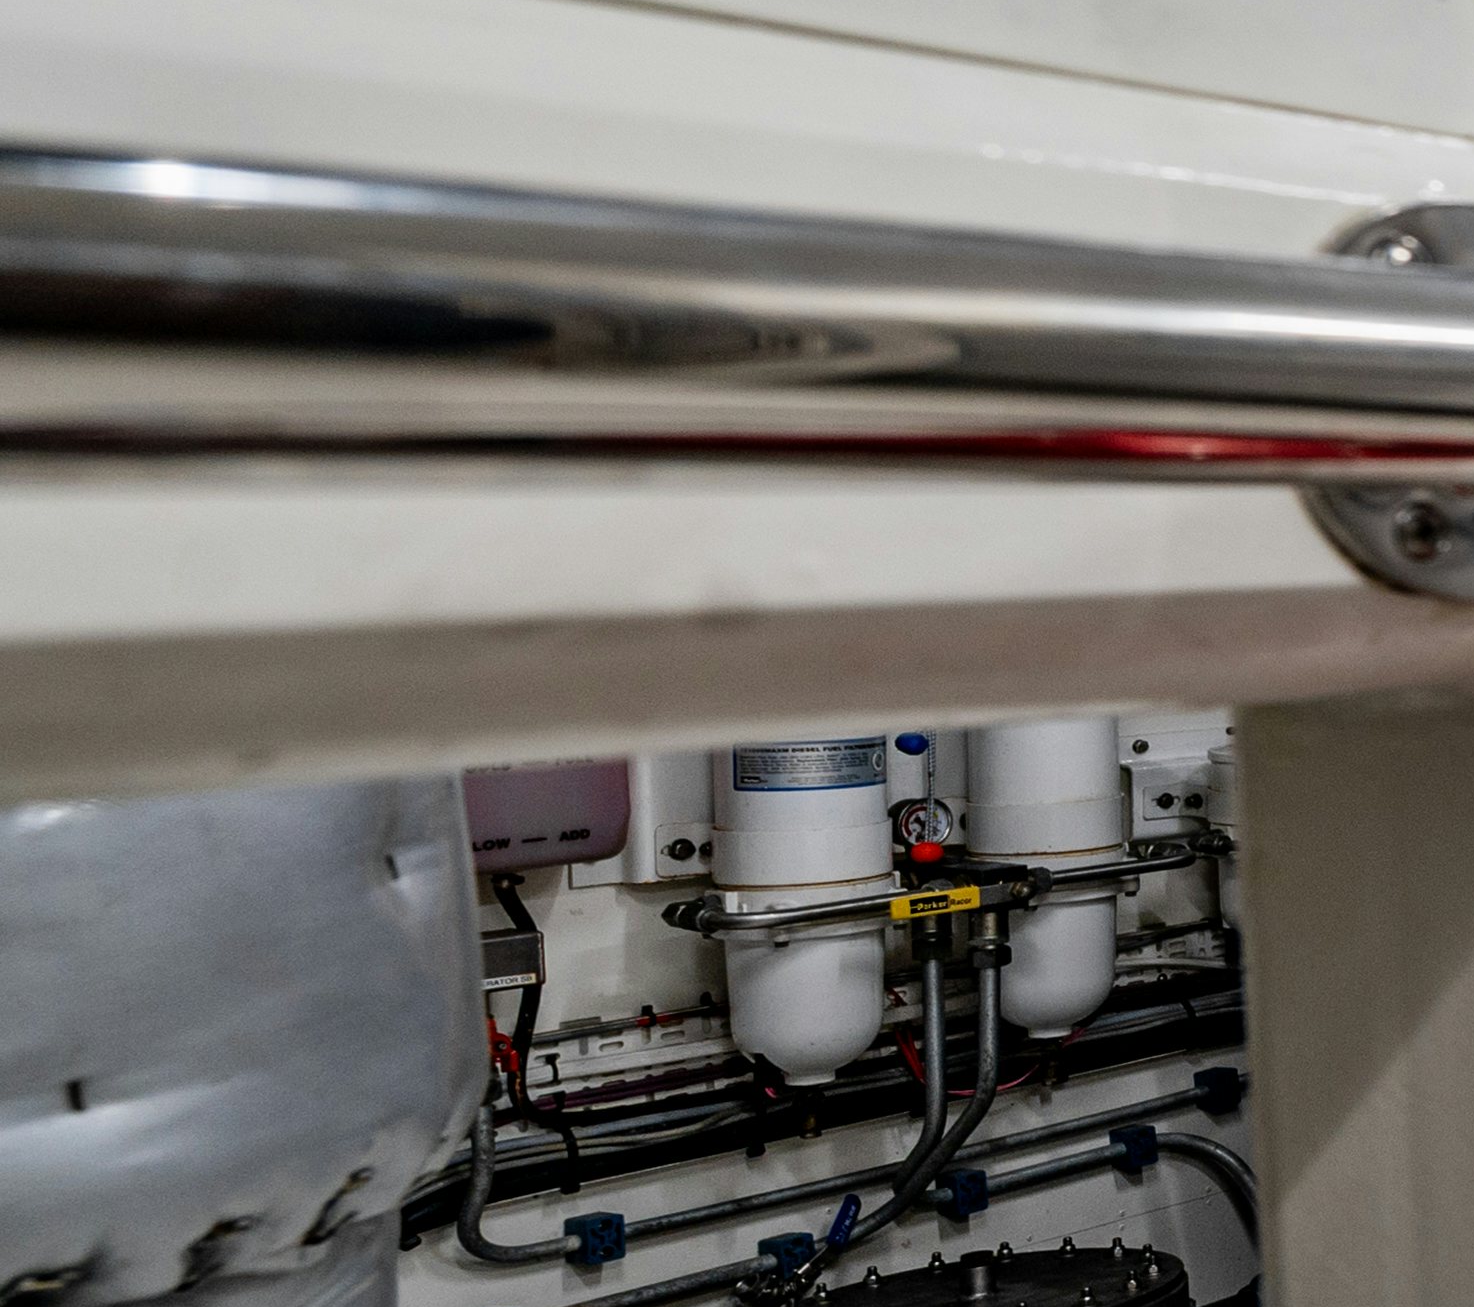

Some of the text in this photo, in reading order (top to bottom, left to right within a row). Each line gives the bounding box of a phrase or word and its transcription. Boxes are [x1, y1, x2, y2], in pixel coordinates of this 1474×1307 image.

[472, 829, 591, 852] LOW ADD
[916, 897, 972, 911] Parker Racor
